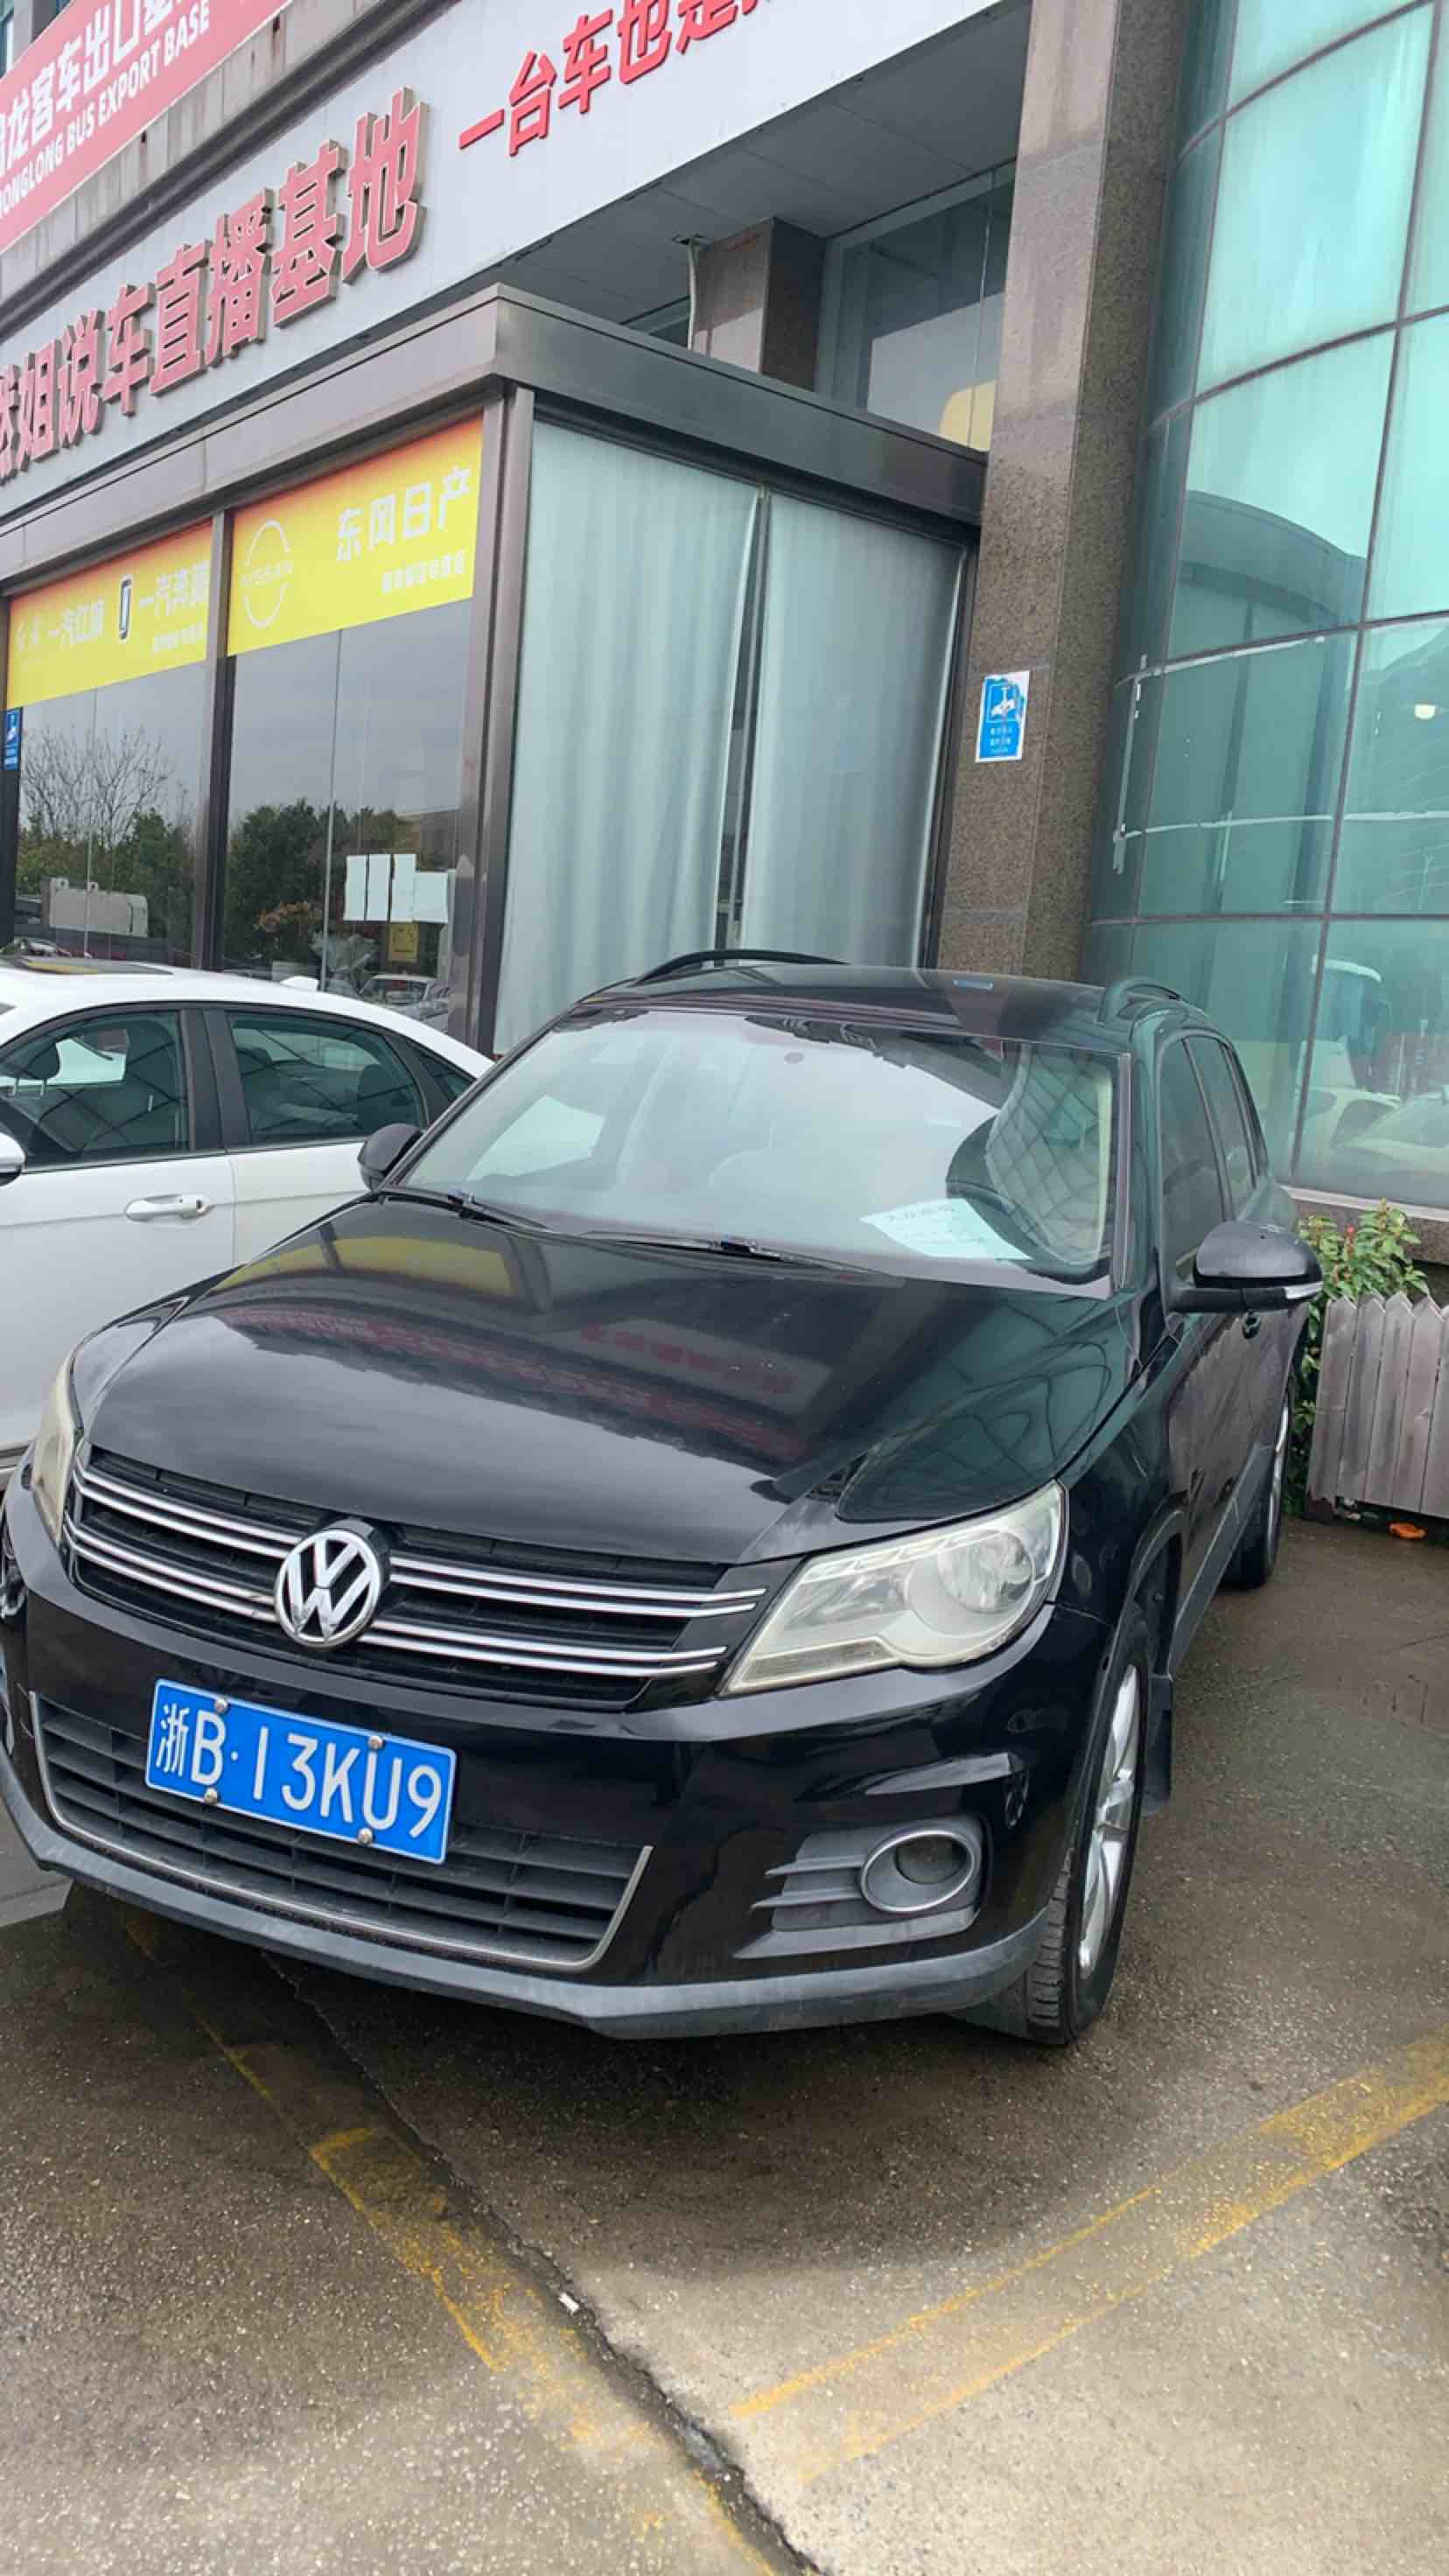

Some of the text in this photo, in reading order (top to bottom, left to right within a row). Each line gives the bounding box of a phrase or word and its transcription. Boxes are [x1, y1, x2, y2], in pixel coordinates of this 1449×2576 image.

[0, 0, 211, 215] ONGLONG BUS EXPORT BASE
[458, 0, 759, 157] 一台车也是
[336, 466, 472, 562] 东风日产
